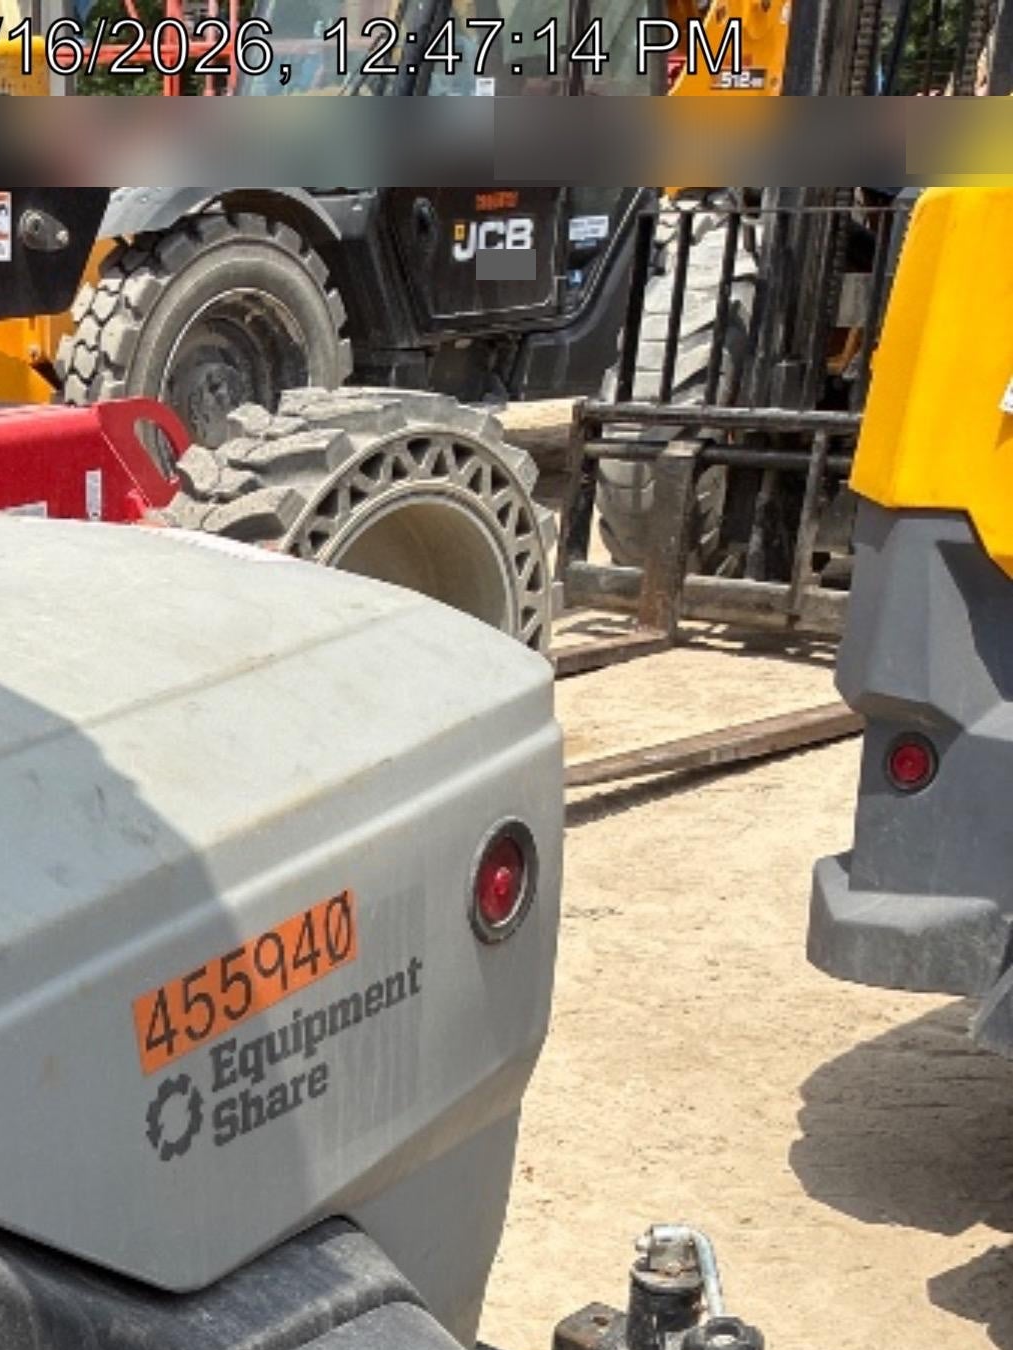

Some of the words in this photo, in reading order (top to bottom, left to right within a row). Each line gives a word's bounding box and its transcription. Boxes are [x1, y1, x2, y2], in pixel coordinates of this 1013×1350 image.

[452, 218, 534, 262] JCB
[145, 890, 351, 1056] 455940
[209, 956, 423, 1093] Equipment
[211, 1061, 329, 1147] Share
